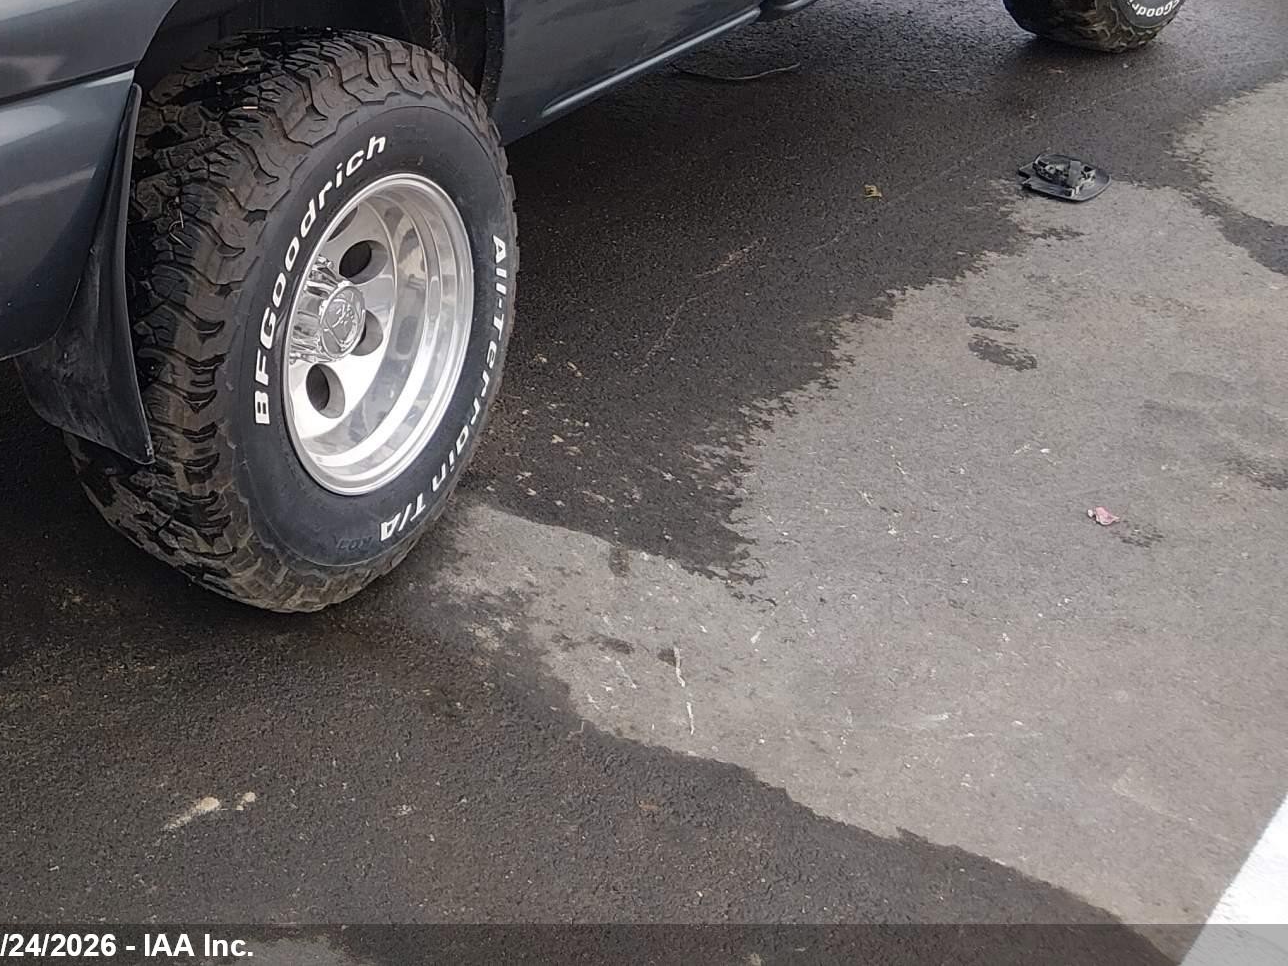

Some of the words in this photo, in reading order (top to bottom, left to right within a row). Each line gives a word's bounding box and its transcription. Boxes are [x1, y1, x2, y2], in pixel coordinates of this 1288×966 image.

[254, 135, 386, 425] BFGoodrich
[431, 234, 508, 493] All-Terrain
[379, 492, 427, 542] T/A
